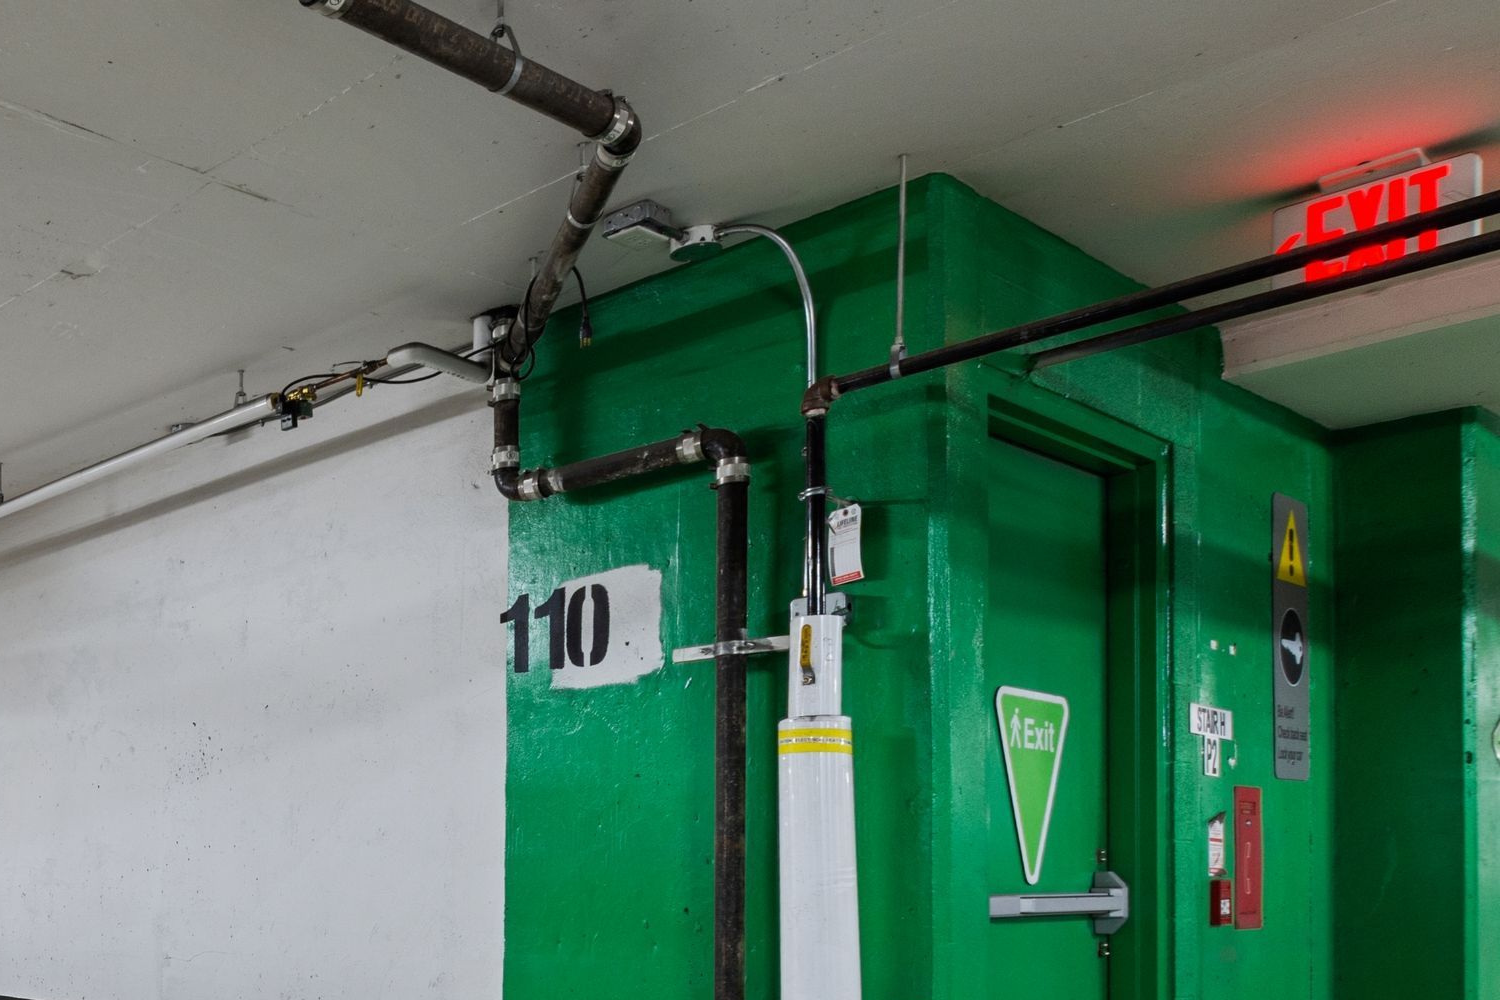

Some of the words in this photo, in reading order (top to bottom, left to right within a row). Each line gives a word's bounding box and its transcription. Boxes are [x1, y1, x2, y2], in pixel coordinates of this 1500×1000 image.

[1306, 164, 1450, 284] EXIT
[500, 583, 610, 673] 110
[1024, 717, 1055, 753] Exit
[1197, 707, 1219, 735] STAIR
[1220, 712, 1226, 737] H
[1207, 738, 1217, 774] P2
